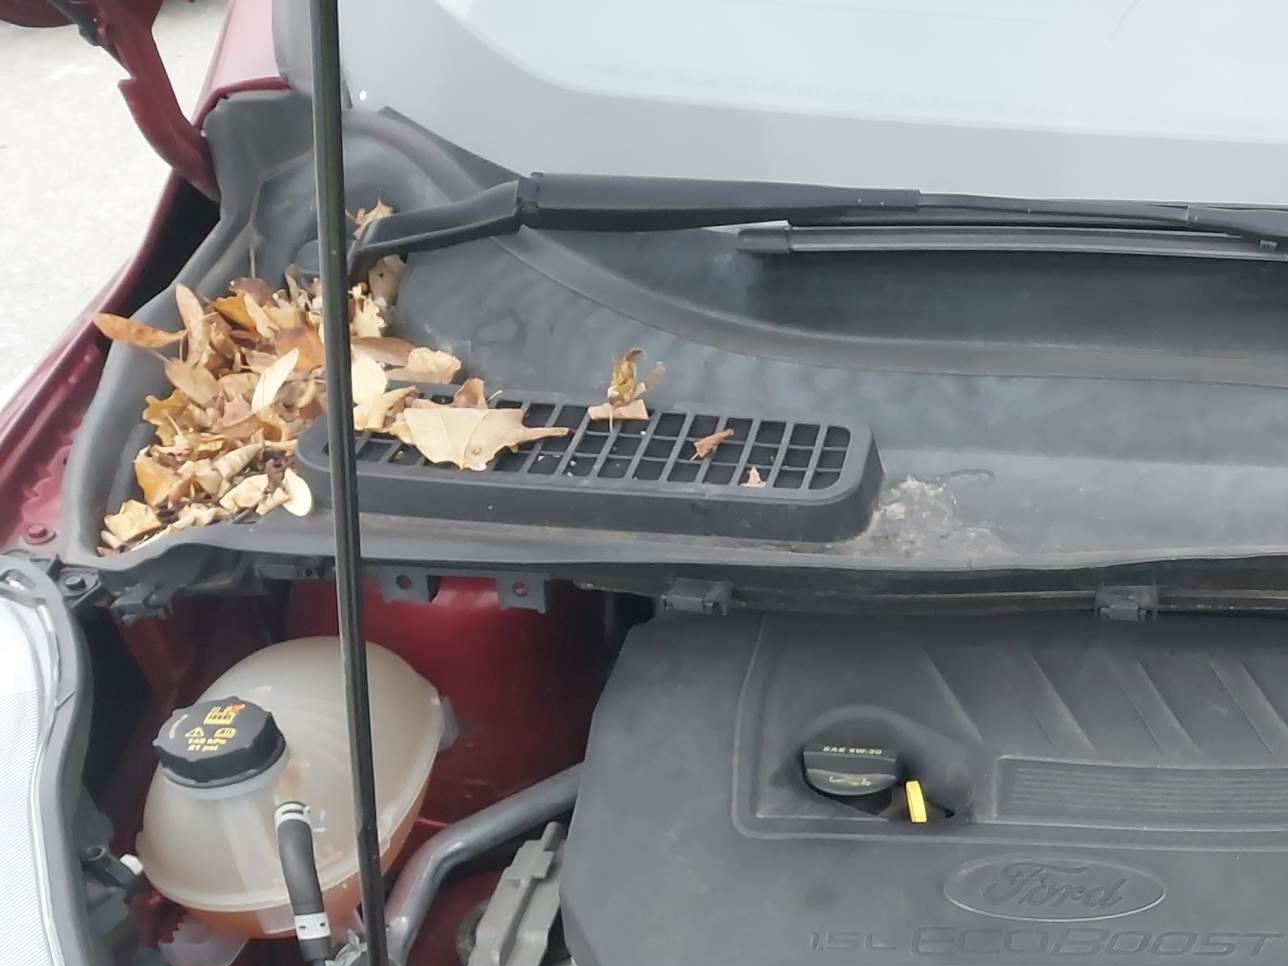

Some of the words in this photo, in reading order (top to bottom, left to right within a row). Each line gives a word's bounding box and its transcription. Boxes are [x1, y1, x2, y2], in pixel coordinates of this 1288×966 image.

[823, 745, 846, 753] SAE
[983, 860, 1129, 908] Ford
[808, 931, 897, 953] 1.5L
